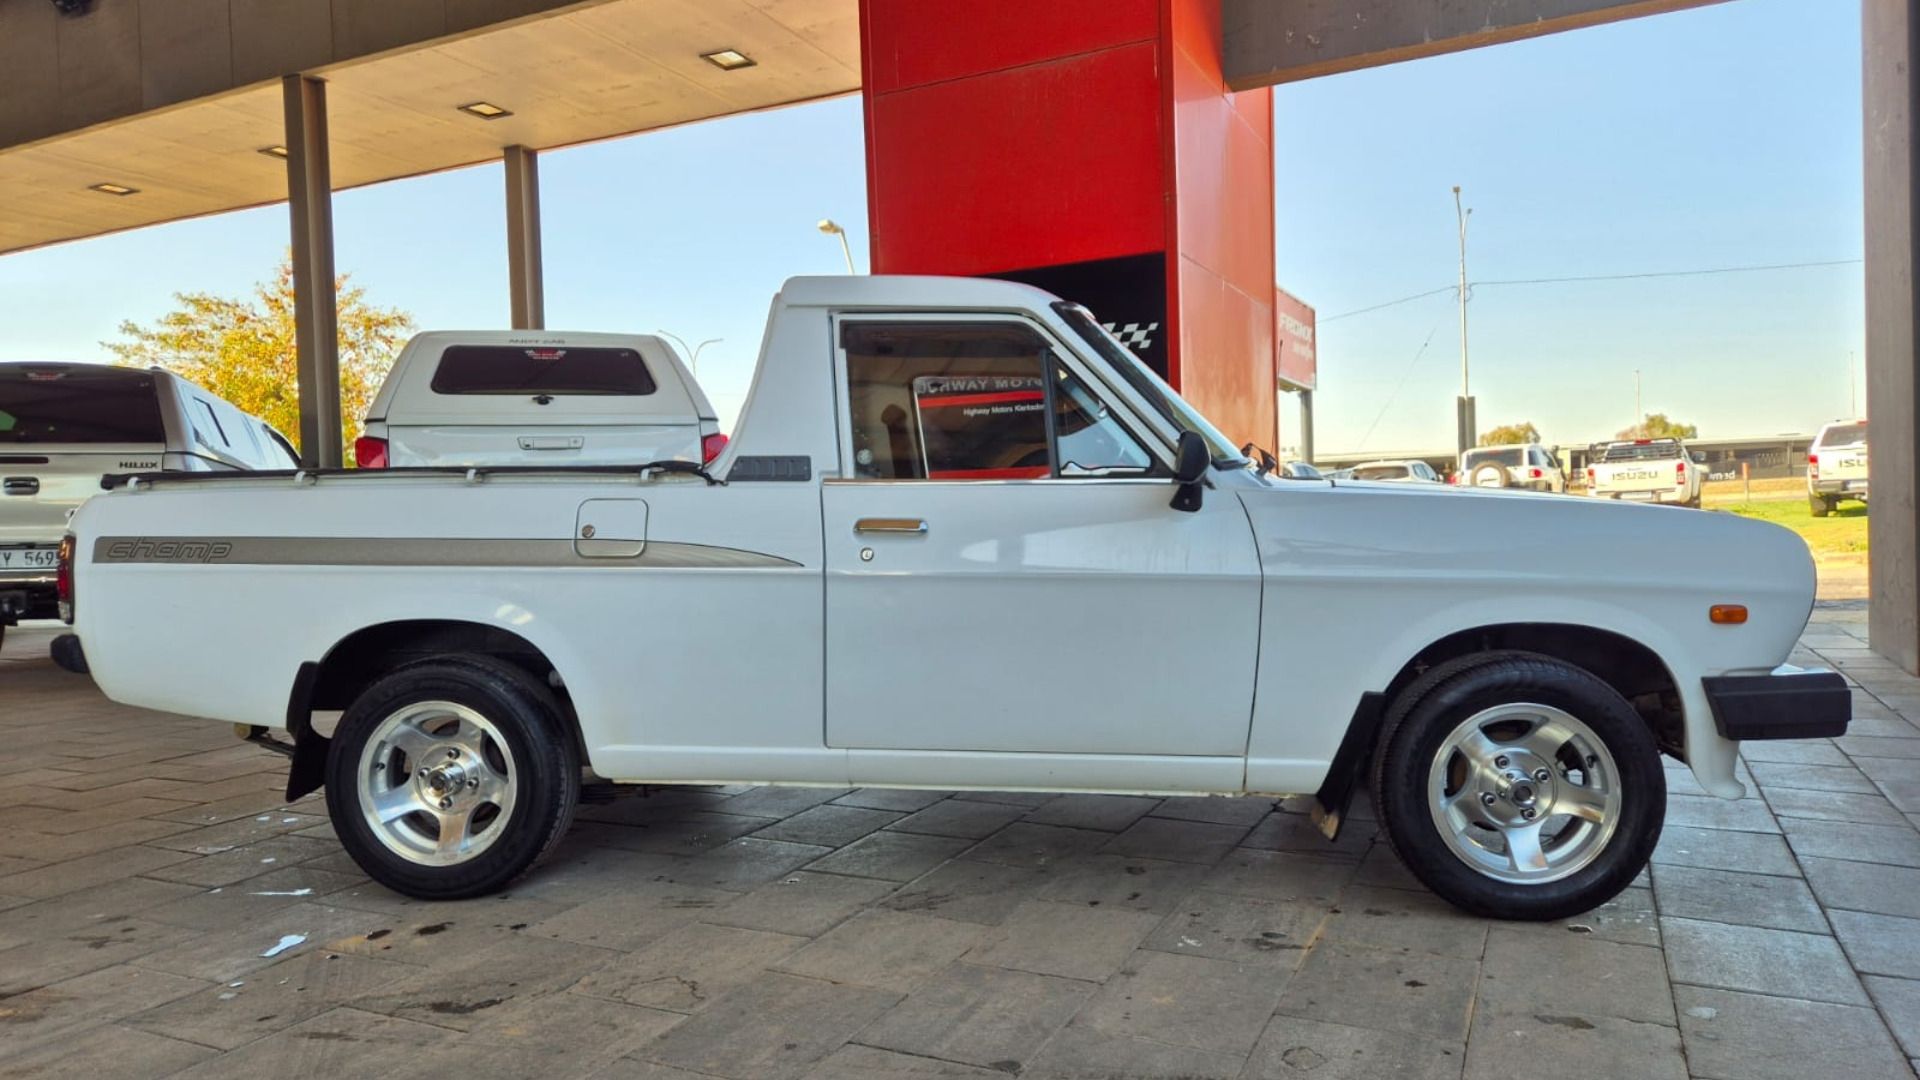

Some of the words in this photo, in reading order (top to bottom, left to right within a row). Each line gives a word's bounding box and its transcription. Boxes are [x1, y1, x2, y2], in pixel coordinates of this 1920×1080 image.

[118, 461, 158, 469] HILUX
[1612, 470, 1659, 481] ISUZU
[107, 537, 233, 563] champ
